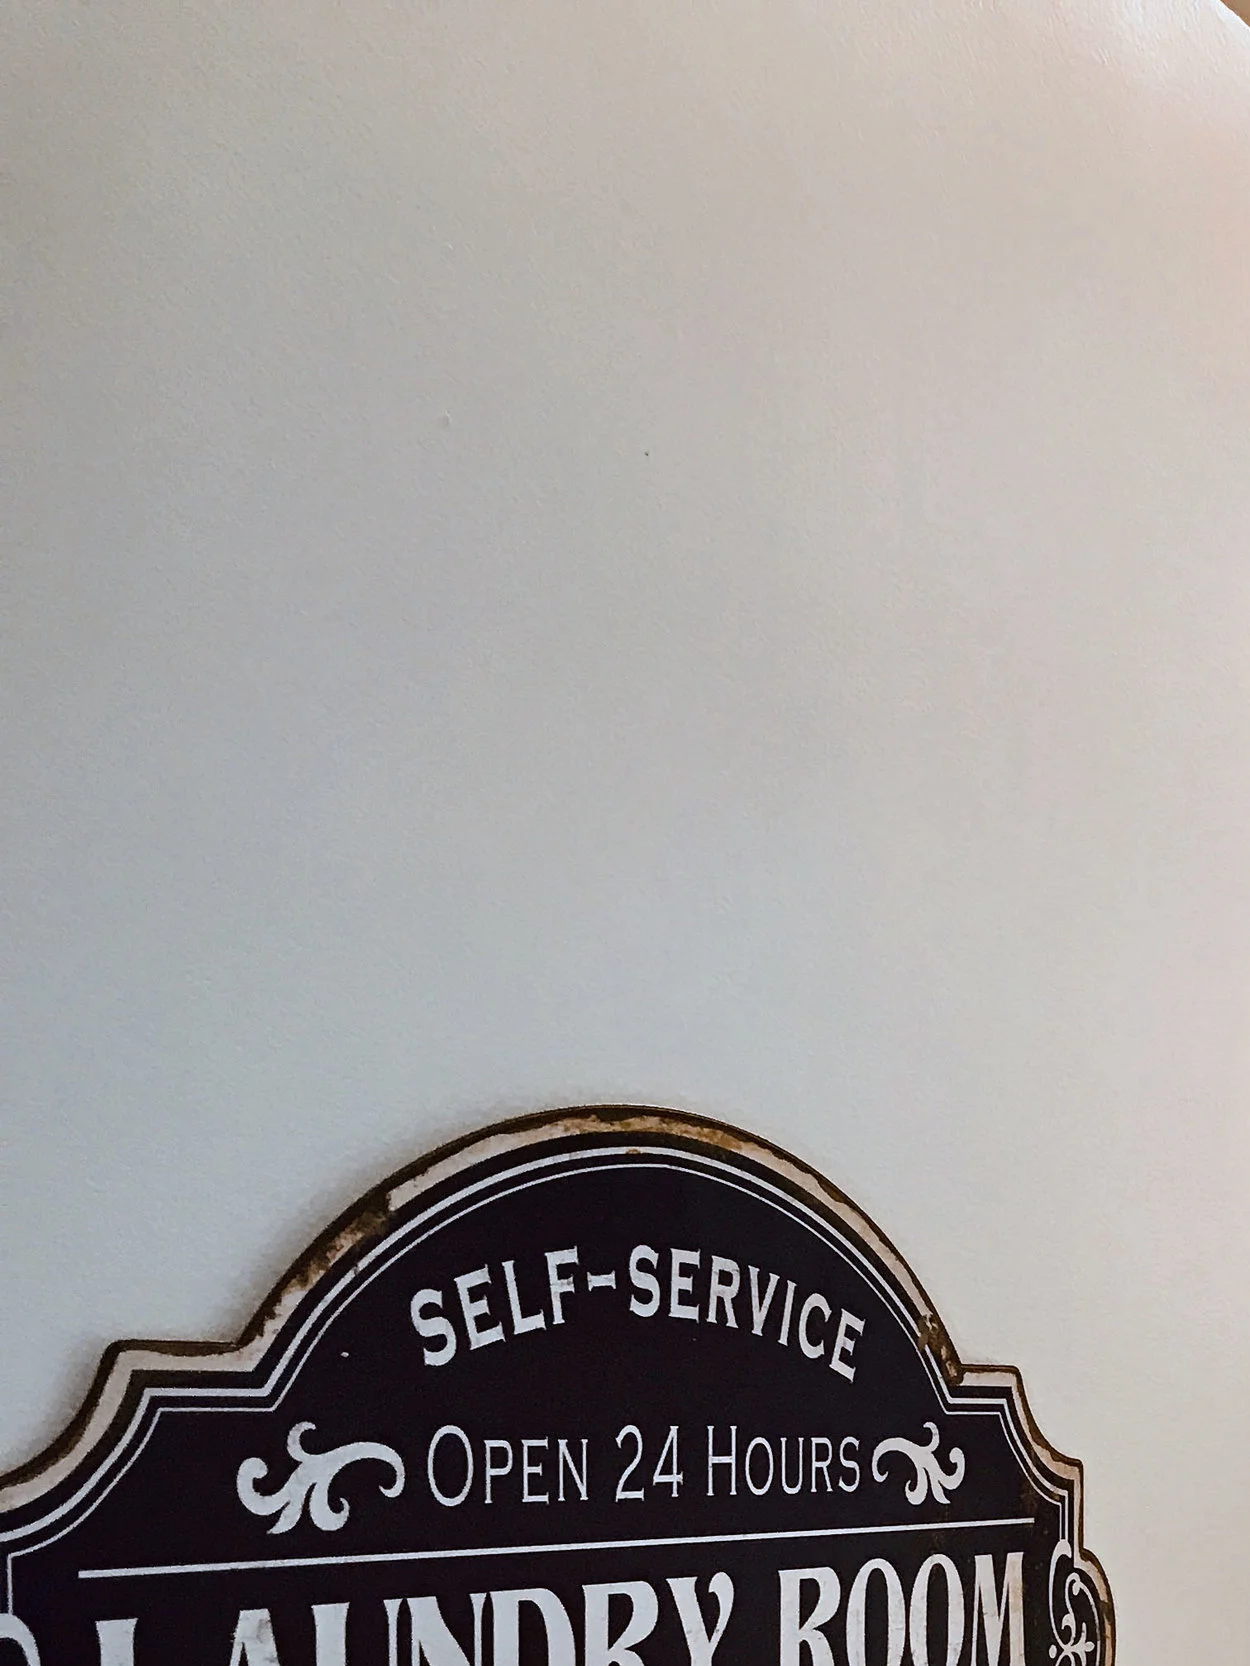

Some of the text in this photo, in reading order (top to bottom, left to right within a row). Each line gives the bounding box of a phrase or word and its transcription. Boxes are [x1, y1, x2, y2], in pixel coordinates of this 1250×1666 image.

[410, 1244, 866, 1383] SELF-SERVICE
[427, 1424, 860, 1507] OPEN 24 HOURS
